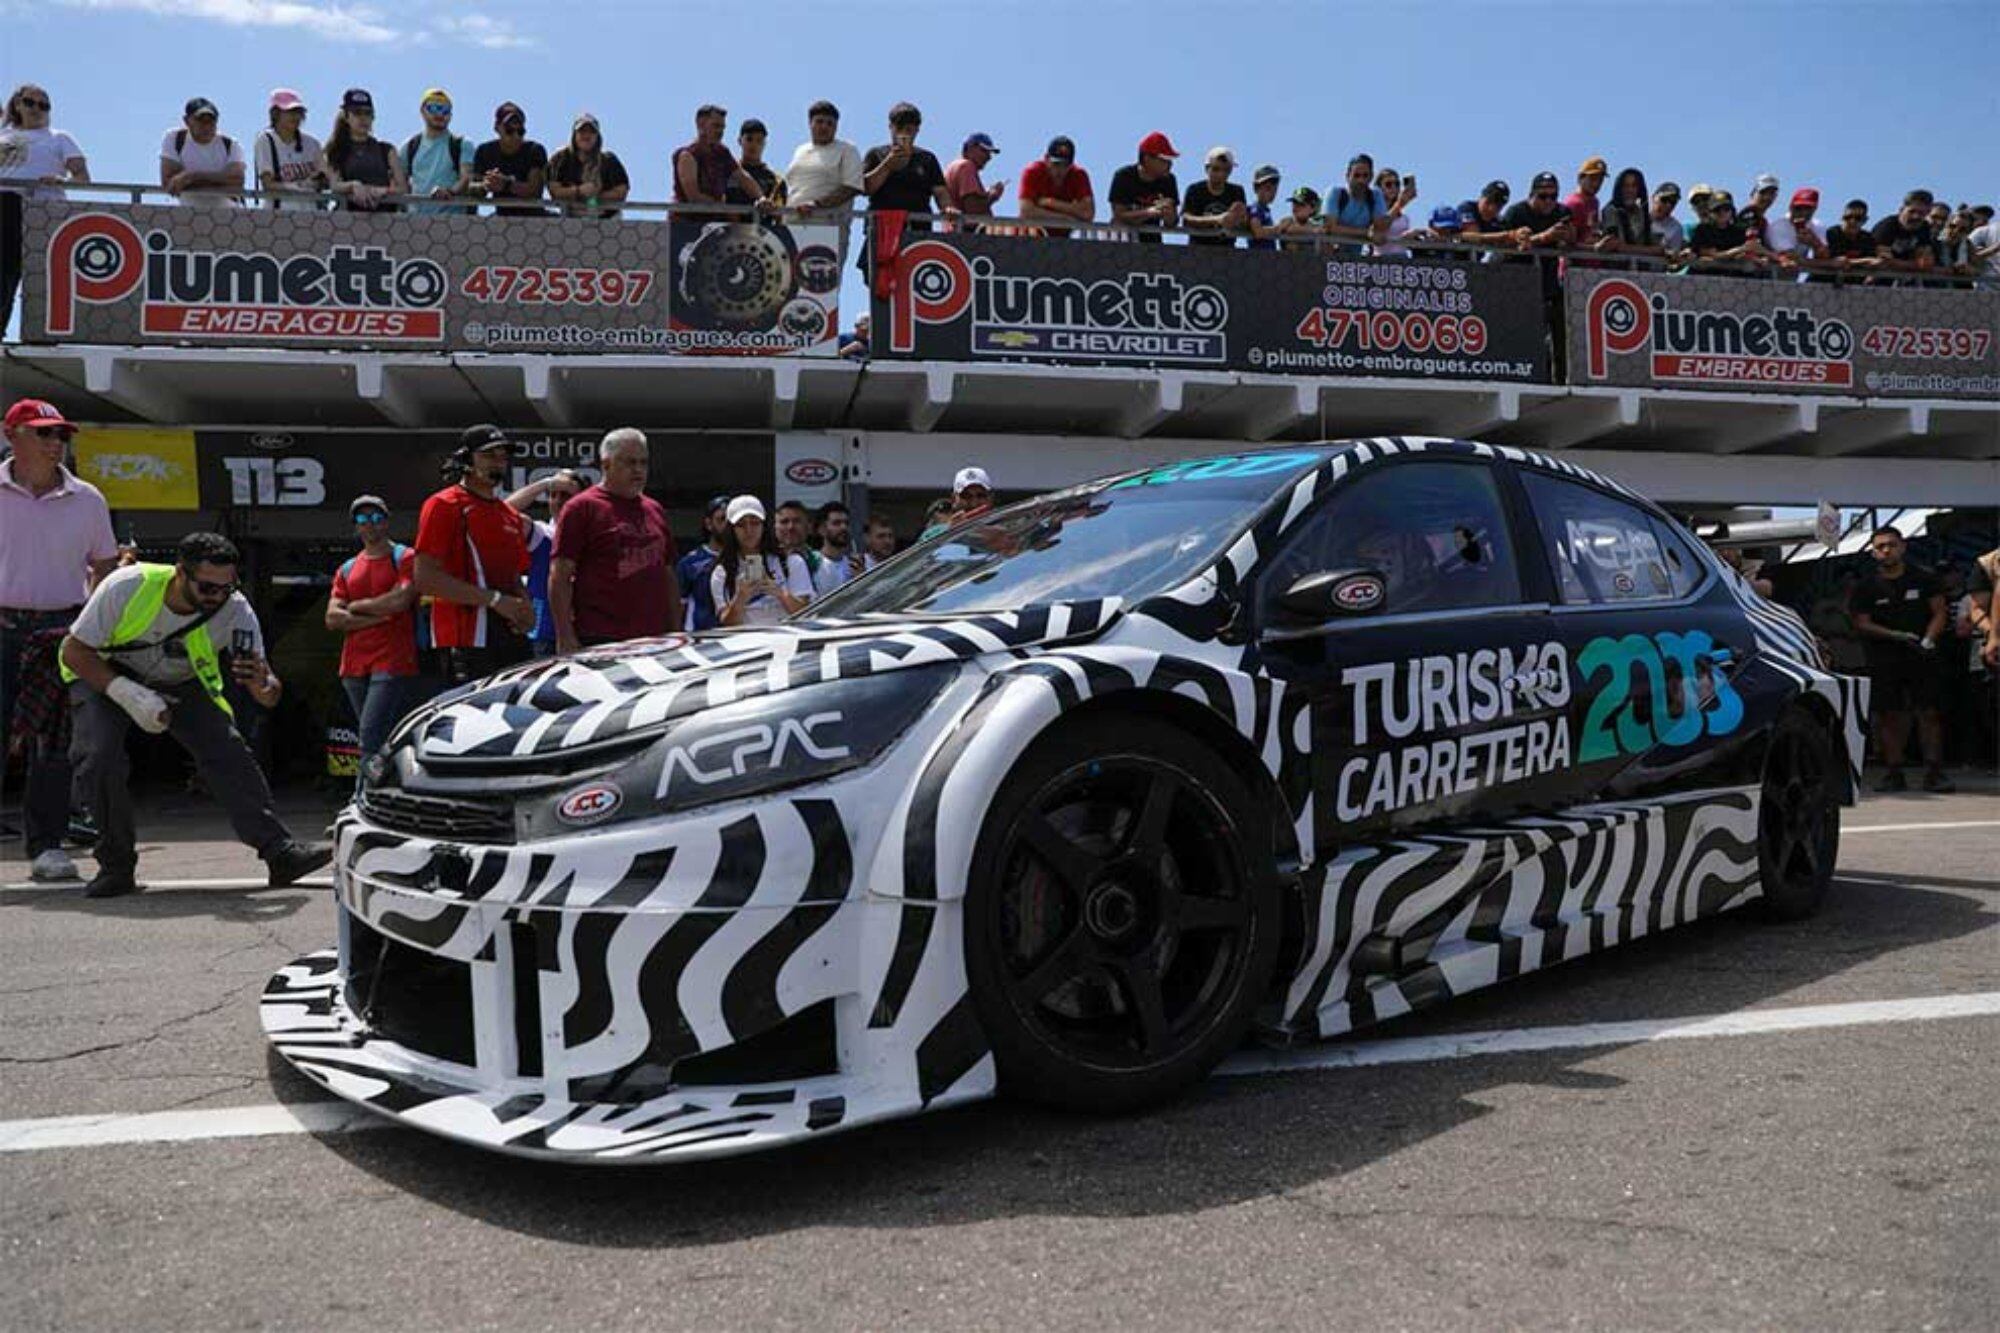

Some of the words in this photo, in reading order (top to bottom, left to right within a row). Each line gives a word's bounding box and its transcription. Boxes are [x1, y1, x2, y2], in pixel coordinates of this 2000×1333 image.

[46, 212, 448, 336] Piumetto
[462, 266, 653, 305] 4725397
[1326, 262, 1467, 288] REPUESTOS
[890, 240, 1228, 351] Piumetto
[1322, 285, 1472, 312] ORIGINALES
[181, 310, 408, 335] EMBRAGUES
[1296, 307, 1487, 354] 4710069
[1586, 278, 1852, 380] Piumetto
[1050, 331, 1211, 356] CHEVROLET
[1861, 326, 1991, 361] 4725397
[1677, 358, 1828, 381] EMBRAGUES
[513, 436, 603, 464] odrig
[222, 456, 326, 506] 113
[1341, 641, 1571, 746] TURISMO
[1337, 716, 1571, 824] CARRETERA
